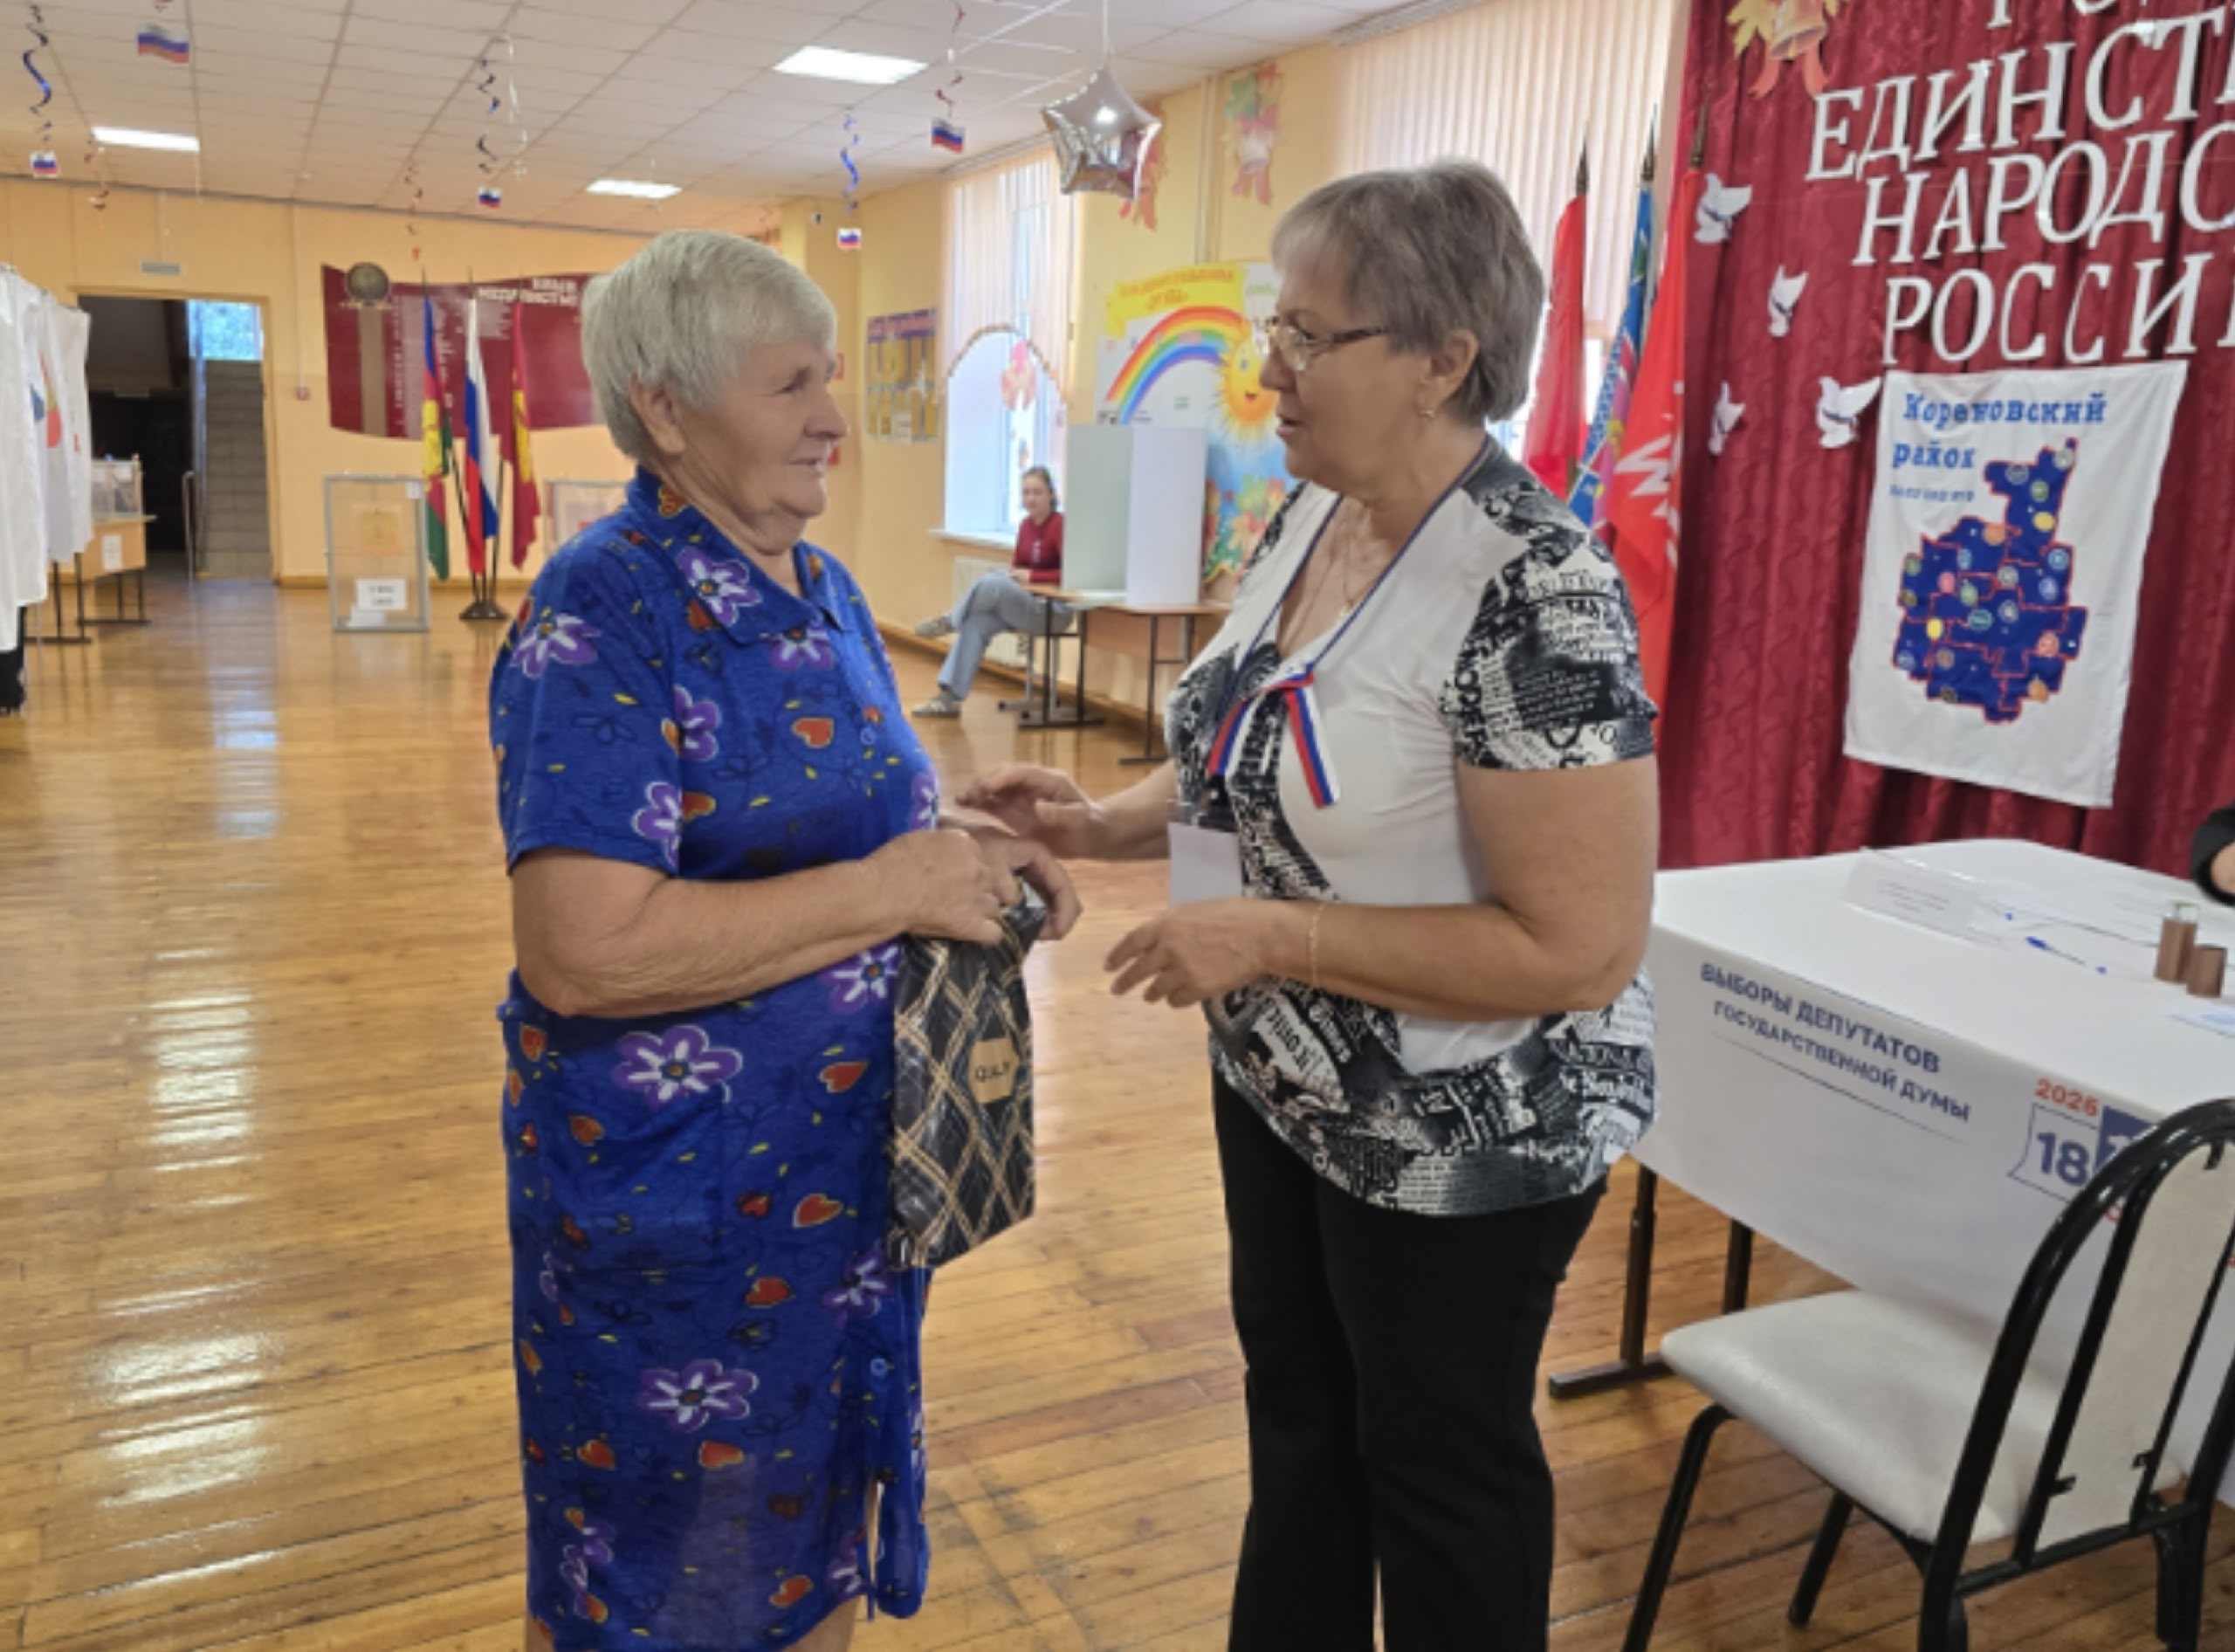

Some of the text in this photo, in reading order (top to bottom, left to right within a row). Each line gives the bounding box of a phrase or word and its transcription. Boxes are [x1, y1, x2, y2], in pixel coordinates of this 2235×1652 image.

[1805, 7, 2235, 181] ЕДИНСТ
[1881, 251, 2235, 366] РОССИ
[1903, 393, 2107, 430] Кореновский
[1701, 963, 1941, 1074] ВЫБОРЫ ДЕПУТАТОВ
[1713, 1001, 1898, 1091] ГОСУДАРСТВЕННОЙ
[1899, 1078, 1970, 1123] ДУМЫ
[2034, 1077, 2100, 1119] 2026
[2037, 1132, 2090, 1187] 18
